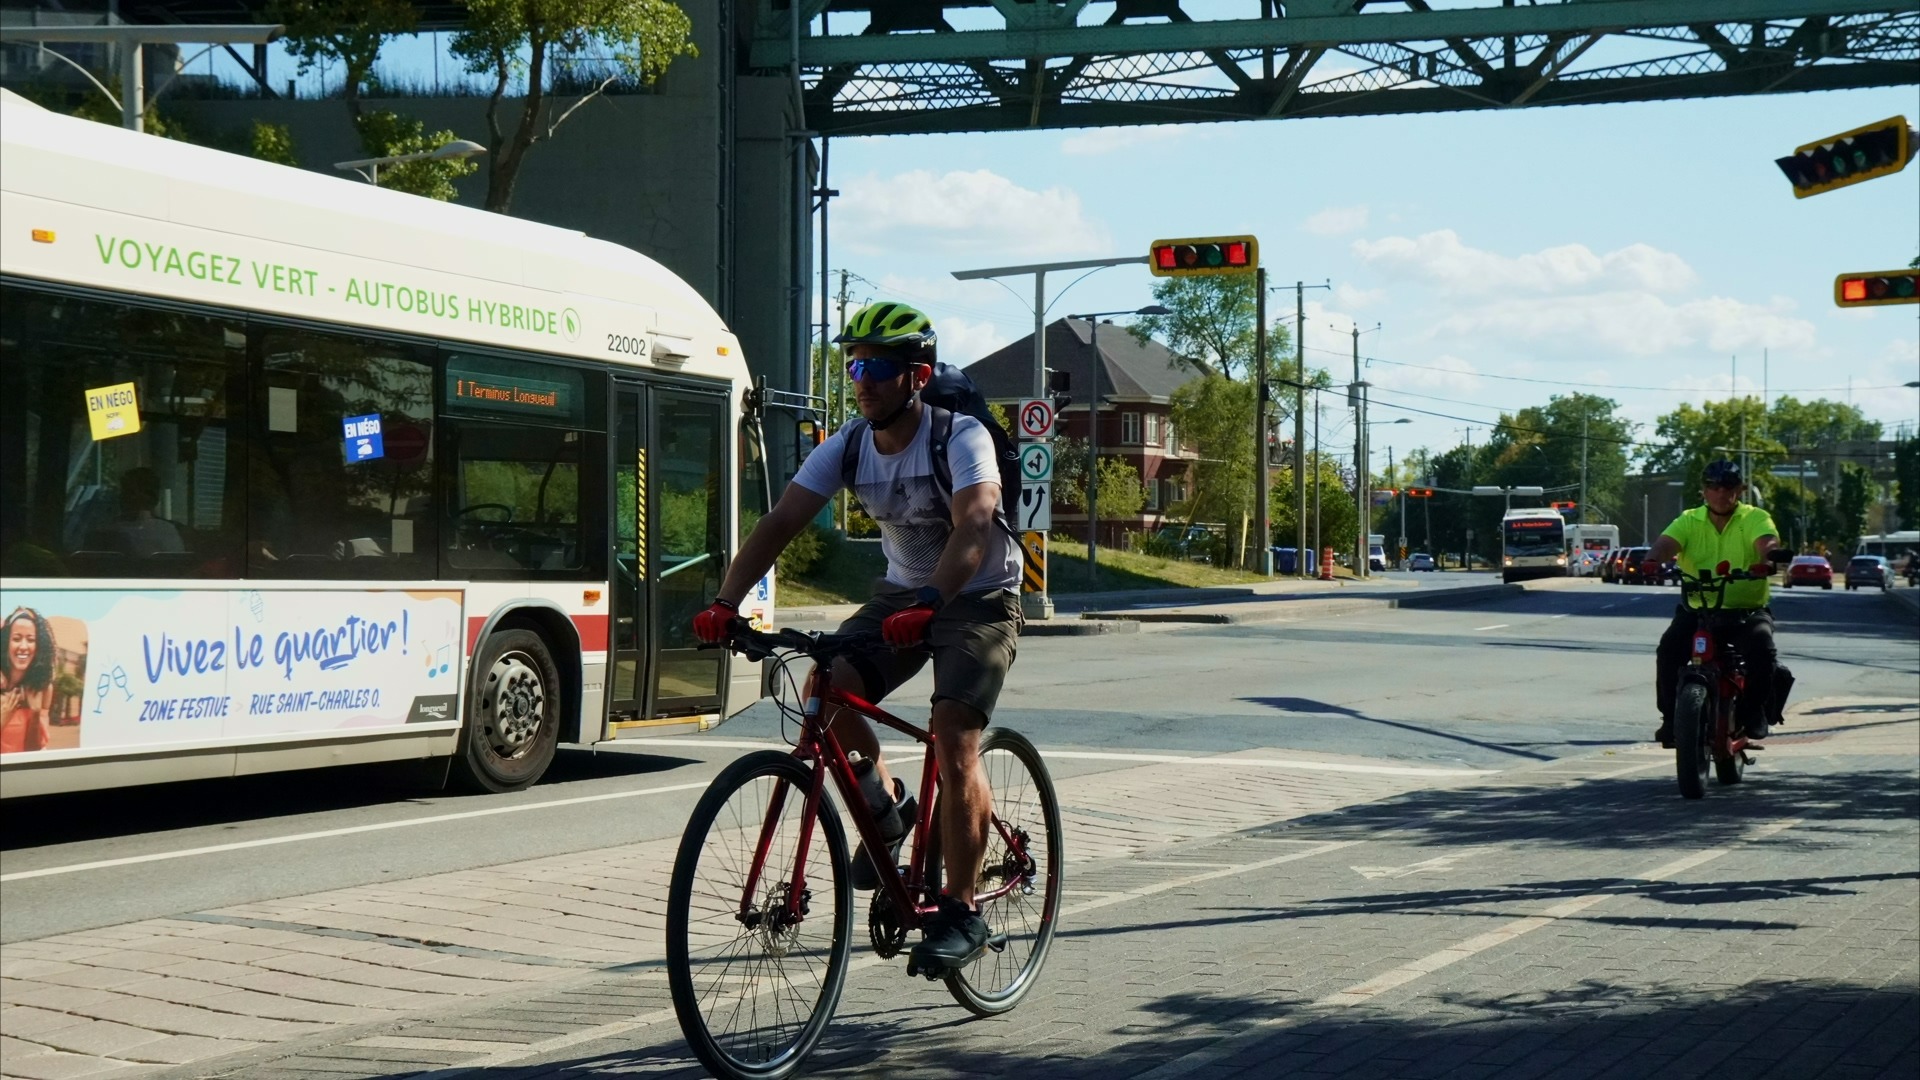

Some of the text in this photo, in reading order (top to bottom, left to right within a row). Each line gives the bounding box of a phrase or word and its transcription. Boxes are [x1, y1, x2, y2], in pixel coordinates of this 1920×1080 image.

[95, 233, 242, 285] VOYAGEZ
[252, 261, 318, 296] VERT
[345, 278, 460, 319] AUTOBUS
[467, 297, 557, 335] HYBRIDE
[606, 333, 647, 357] 22002
[90, 388, 134, 412] EN NÉGO
[457, 380, 556, 407] 1 Terminus Longueuil
[344, 417, 381, 438] EN NÉGO
[143, 631, 226, 684] Vivez
[235, 625, 264, 670] le
[138, 699, 178, 722] ZONE
[178, 696, 231, 720] FESTIVE
[249, 693, 274, 715] RUE
[276, 688, 370, 714] SAINT-CHARLES
